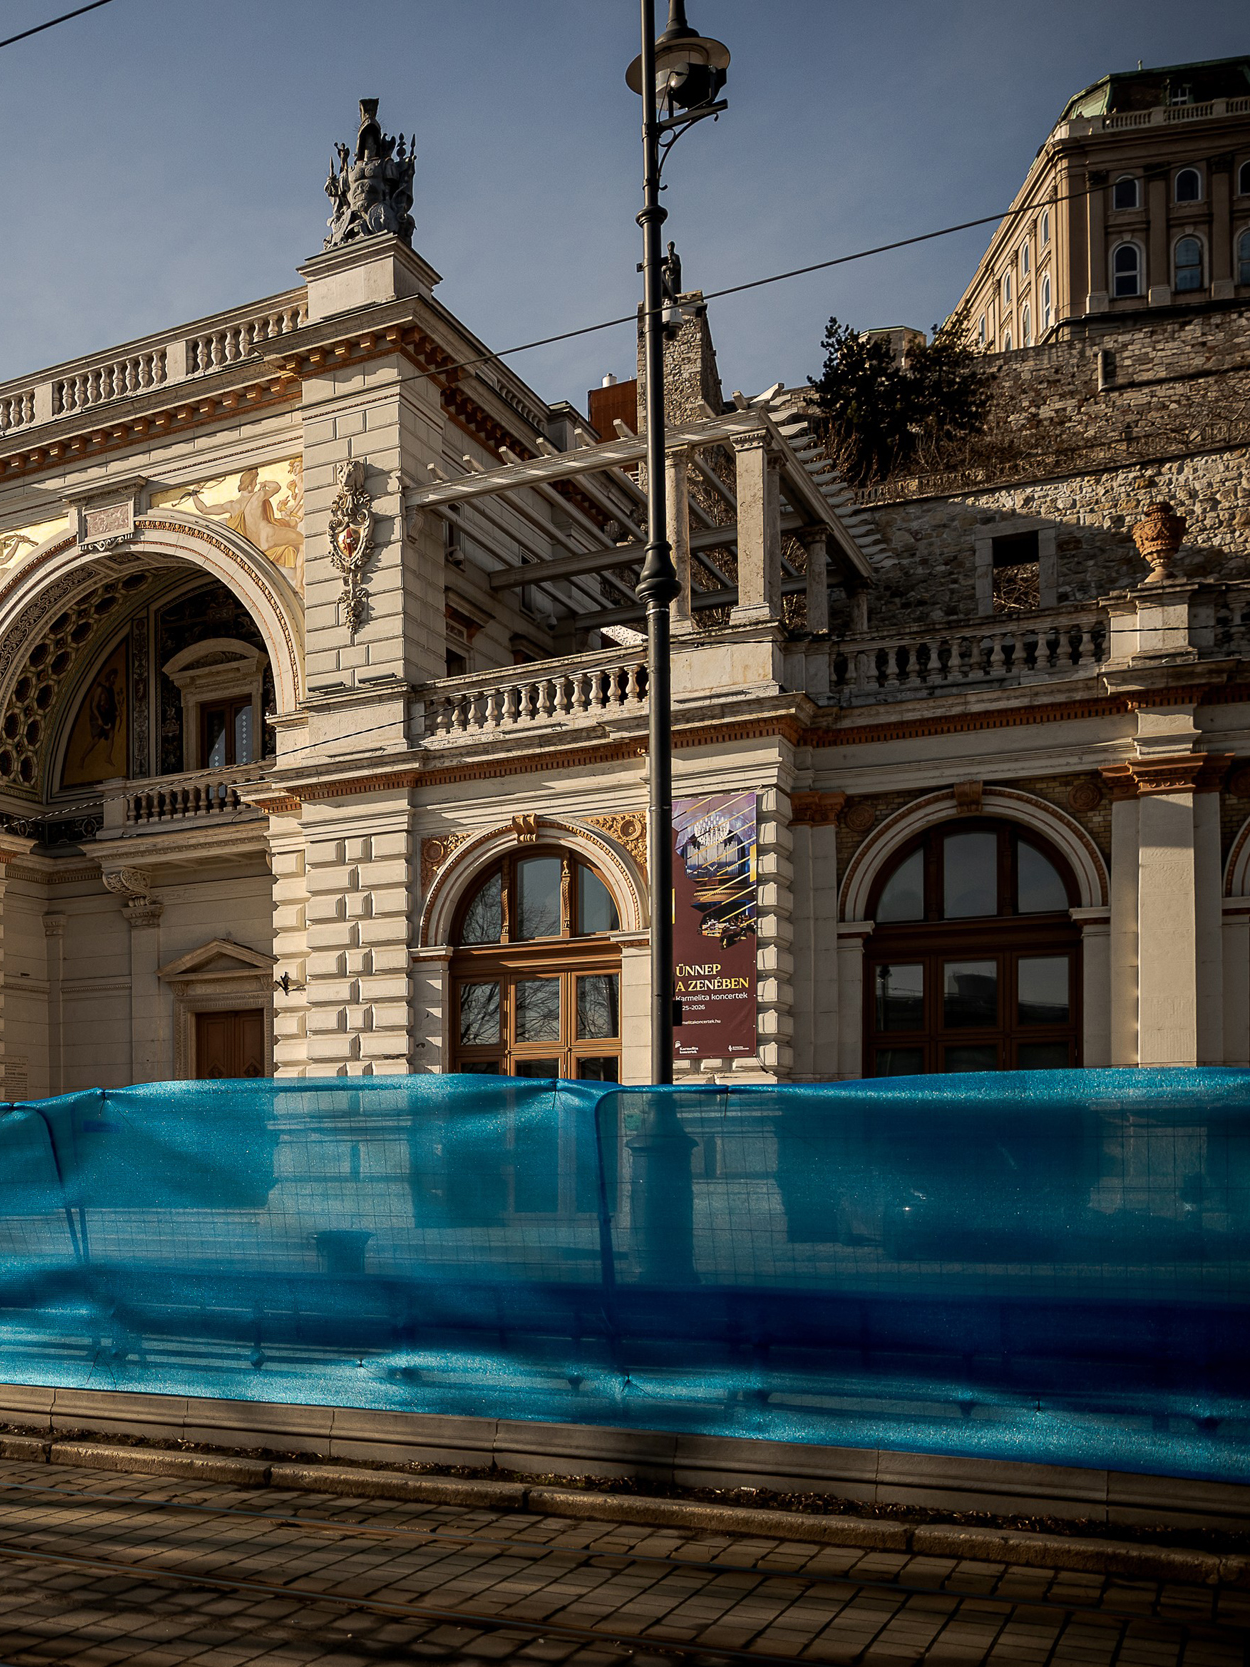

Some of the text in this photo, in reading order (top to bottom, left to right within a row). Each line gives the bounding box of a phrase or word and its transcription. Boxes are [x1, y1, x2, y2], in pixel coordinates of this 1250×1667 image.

[676, 963, 721, 976] ÜNNEP
[675, 976, 749, 992] A ZENÉBEN
[711, 992, 748, 1000] koncertek
